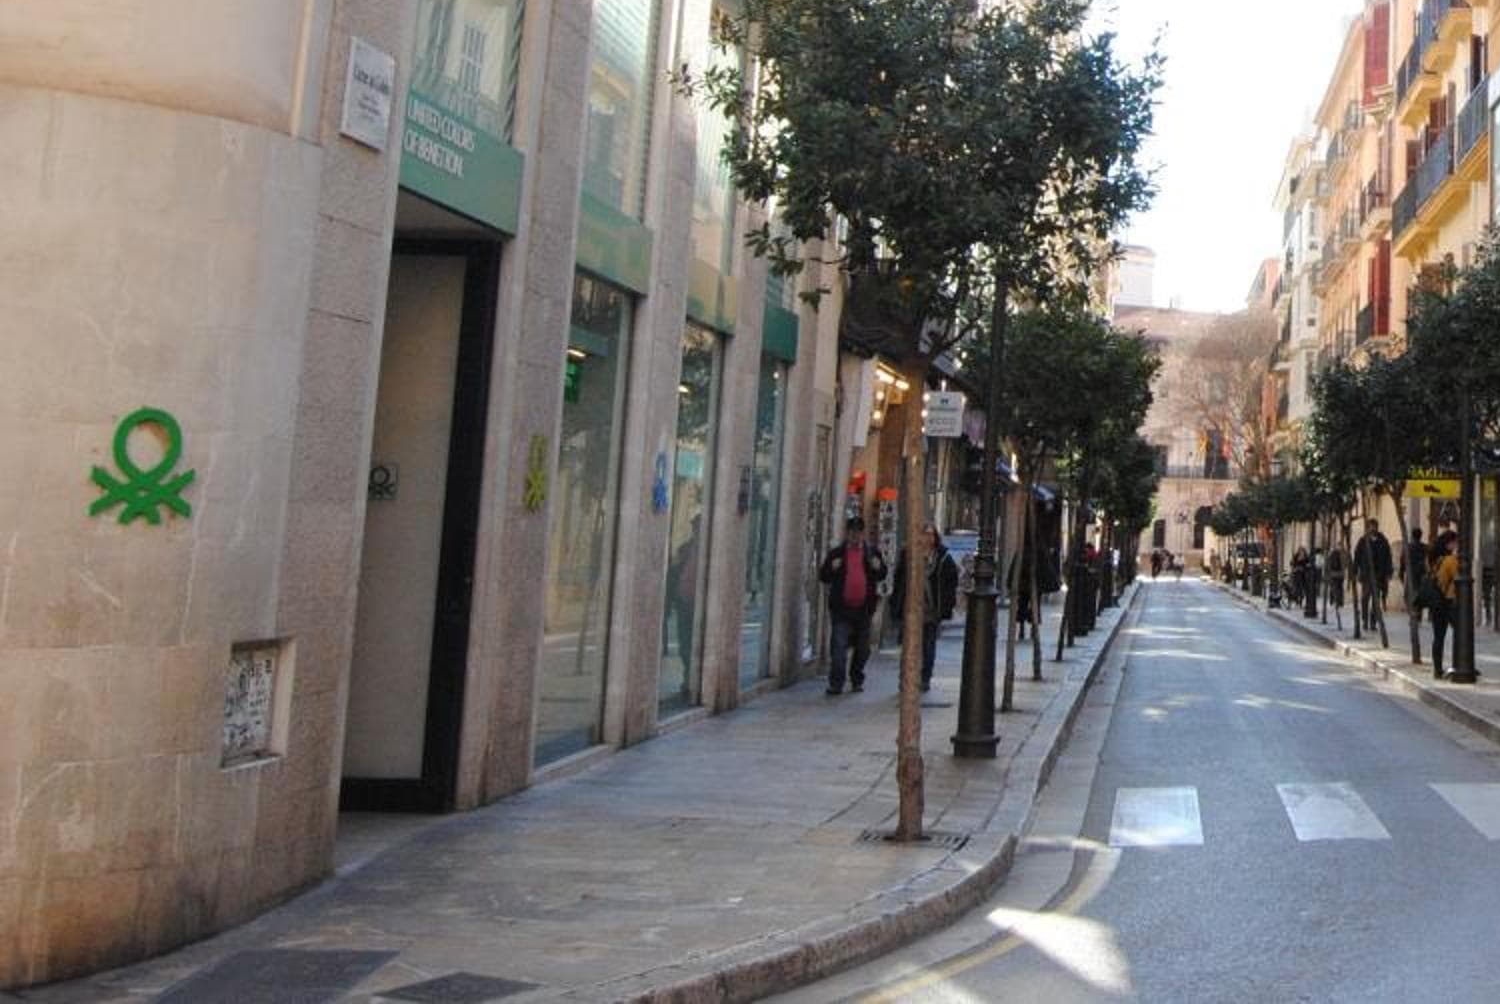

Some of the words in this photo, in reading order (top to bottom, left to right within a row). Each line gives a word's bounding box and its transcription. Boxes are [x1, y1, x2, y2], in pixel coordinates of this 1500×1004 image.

[403, 128, 418, 154] OF
[407, 98, 440, 133] UNITED
[441, 116, 475, 152] COLORS
